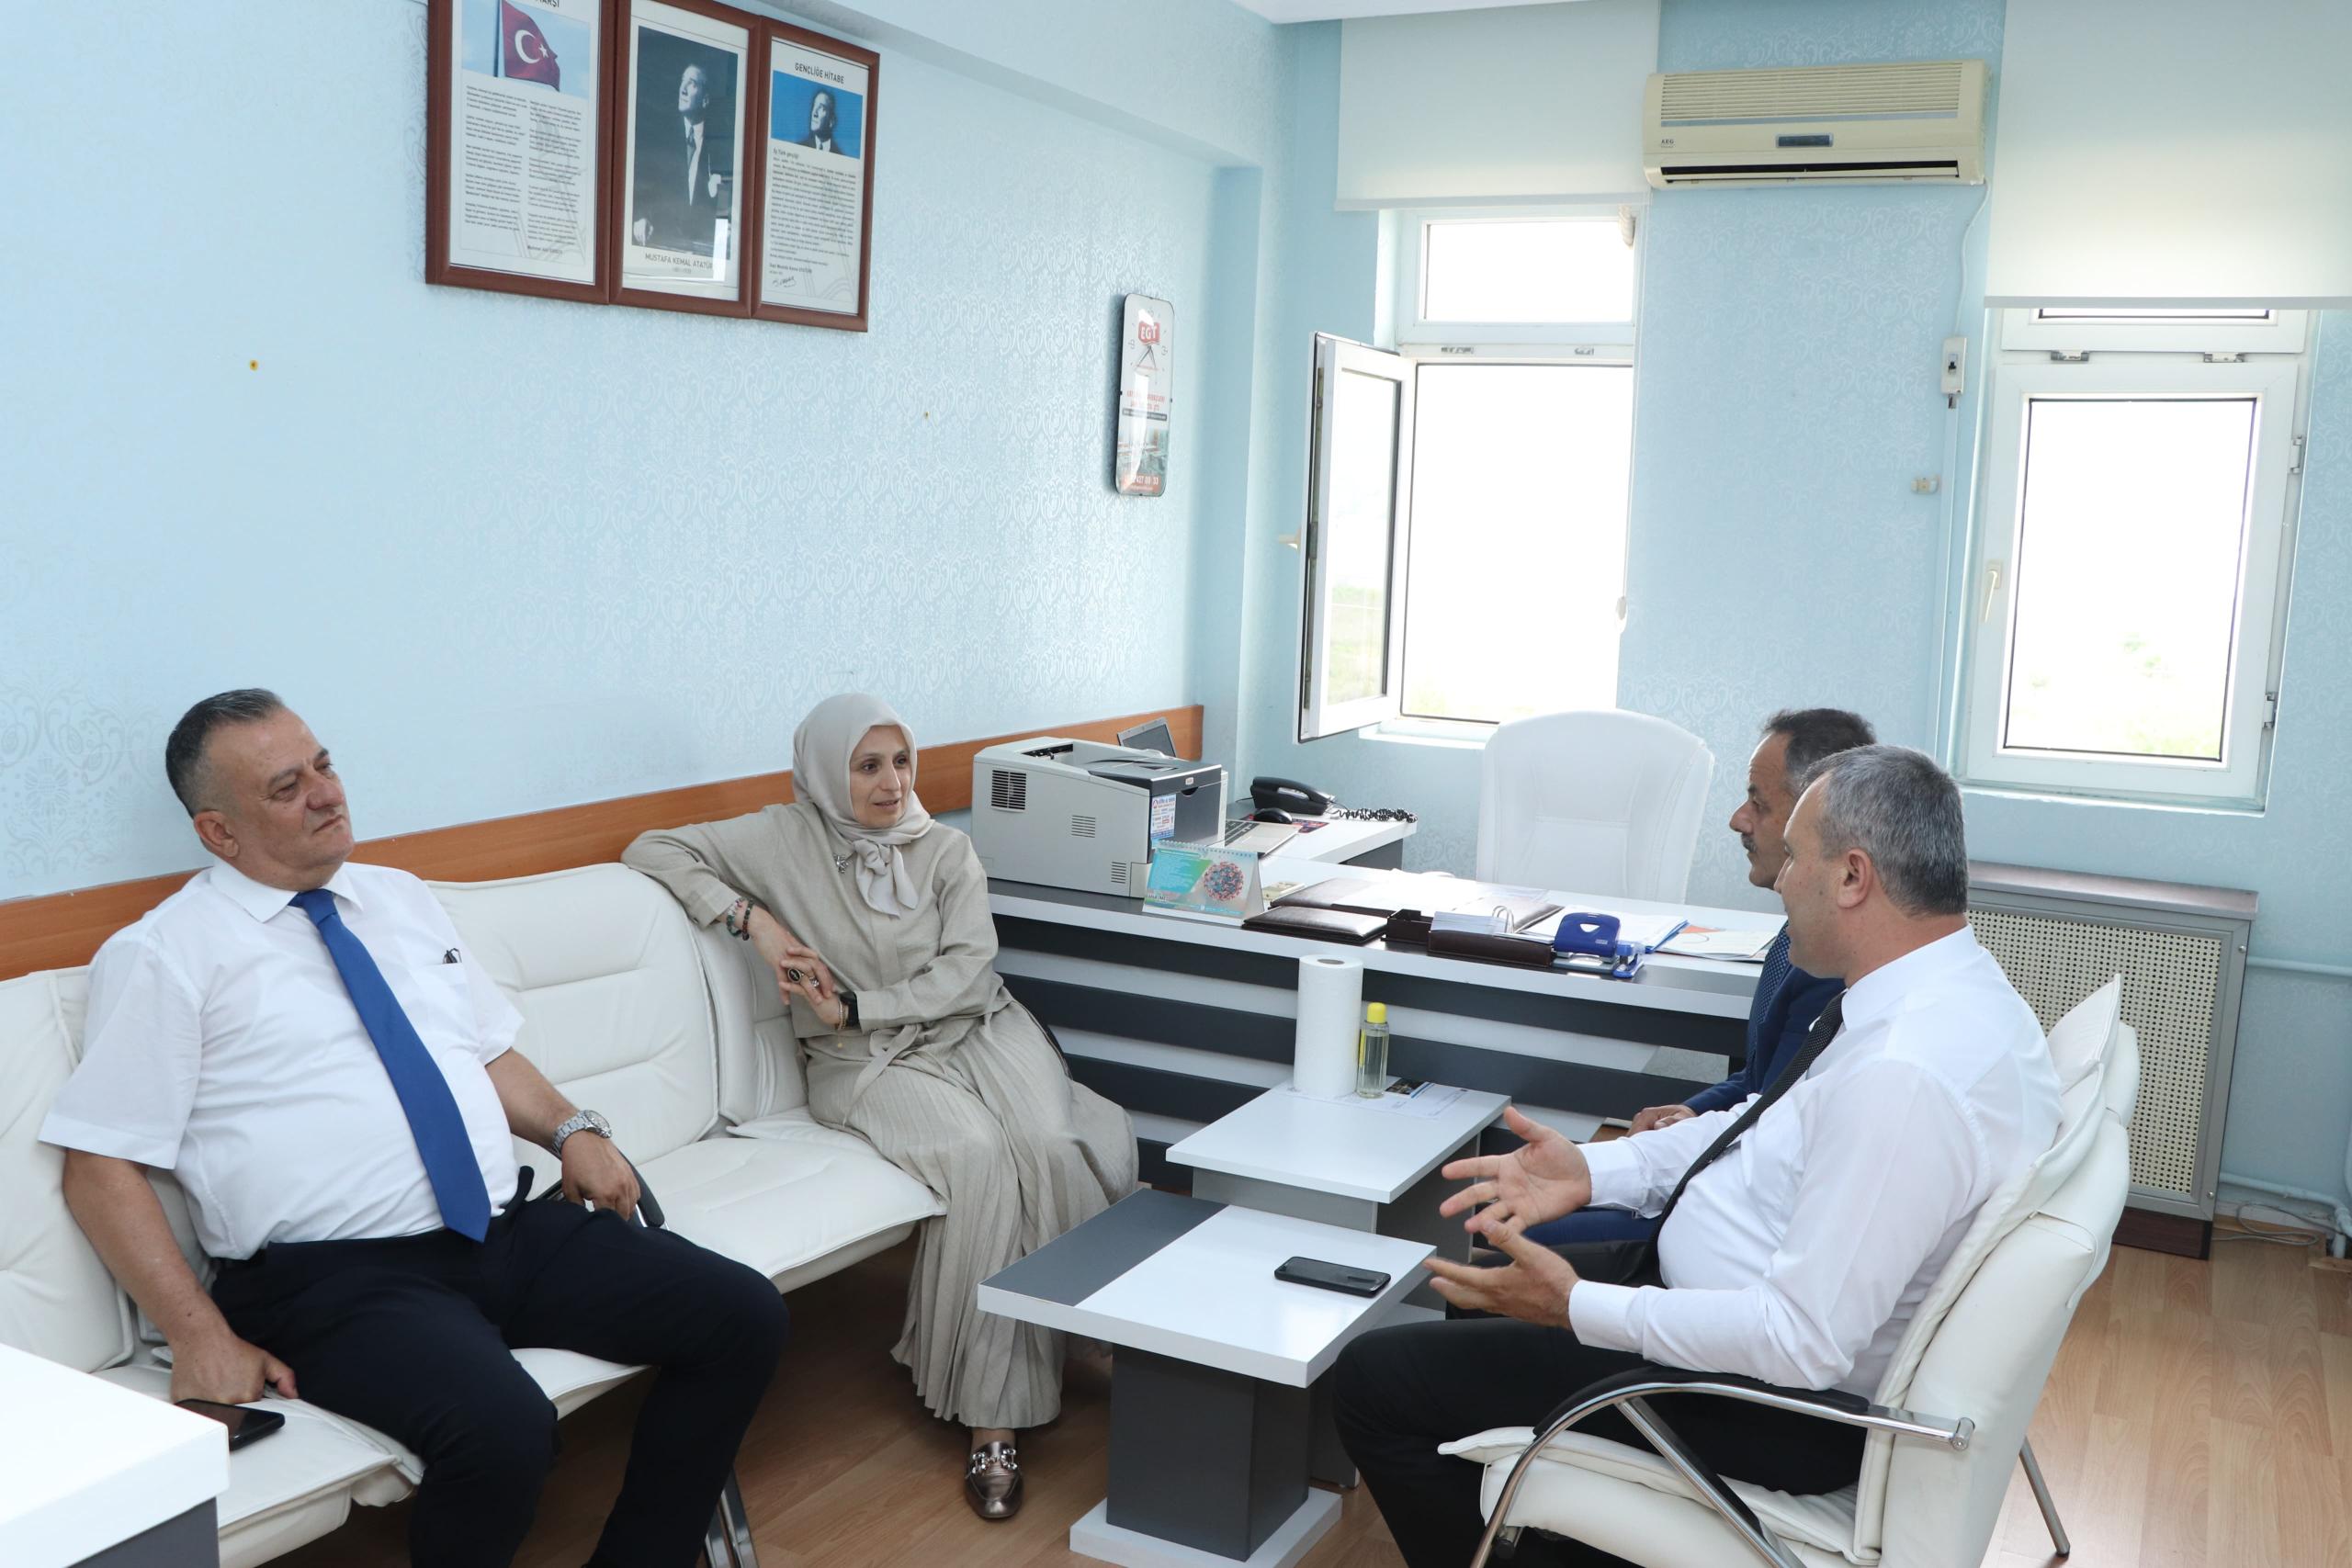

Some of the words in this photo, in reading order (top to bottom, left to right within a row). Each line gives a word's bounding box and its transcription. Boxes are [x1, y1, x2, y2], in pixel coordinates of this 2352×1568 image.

[795, 62, 823, 78] GENÇLİĞE
[824, 70, 844, 84] HİTABE
[645, 253, 672, 264] MUSTAFA
[673, 257, 692, 266] KEMAL
[693, 260, 714, 269] ATATÜR
